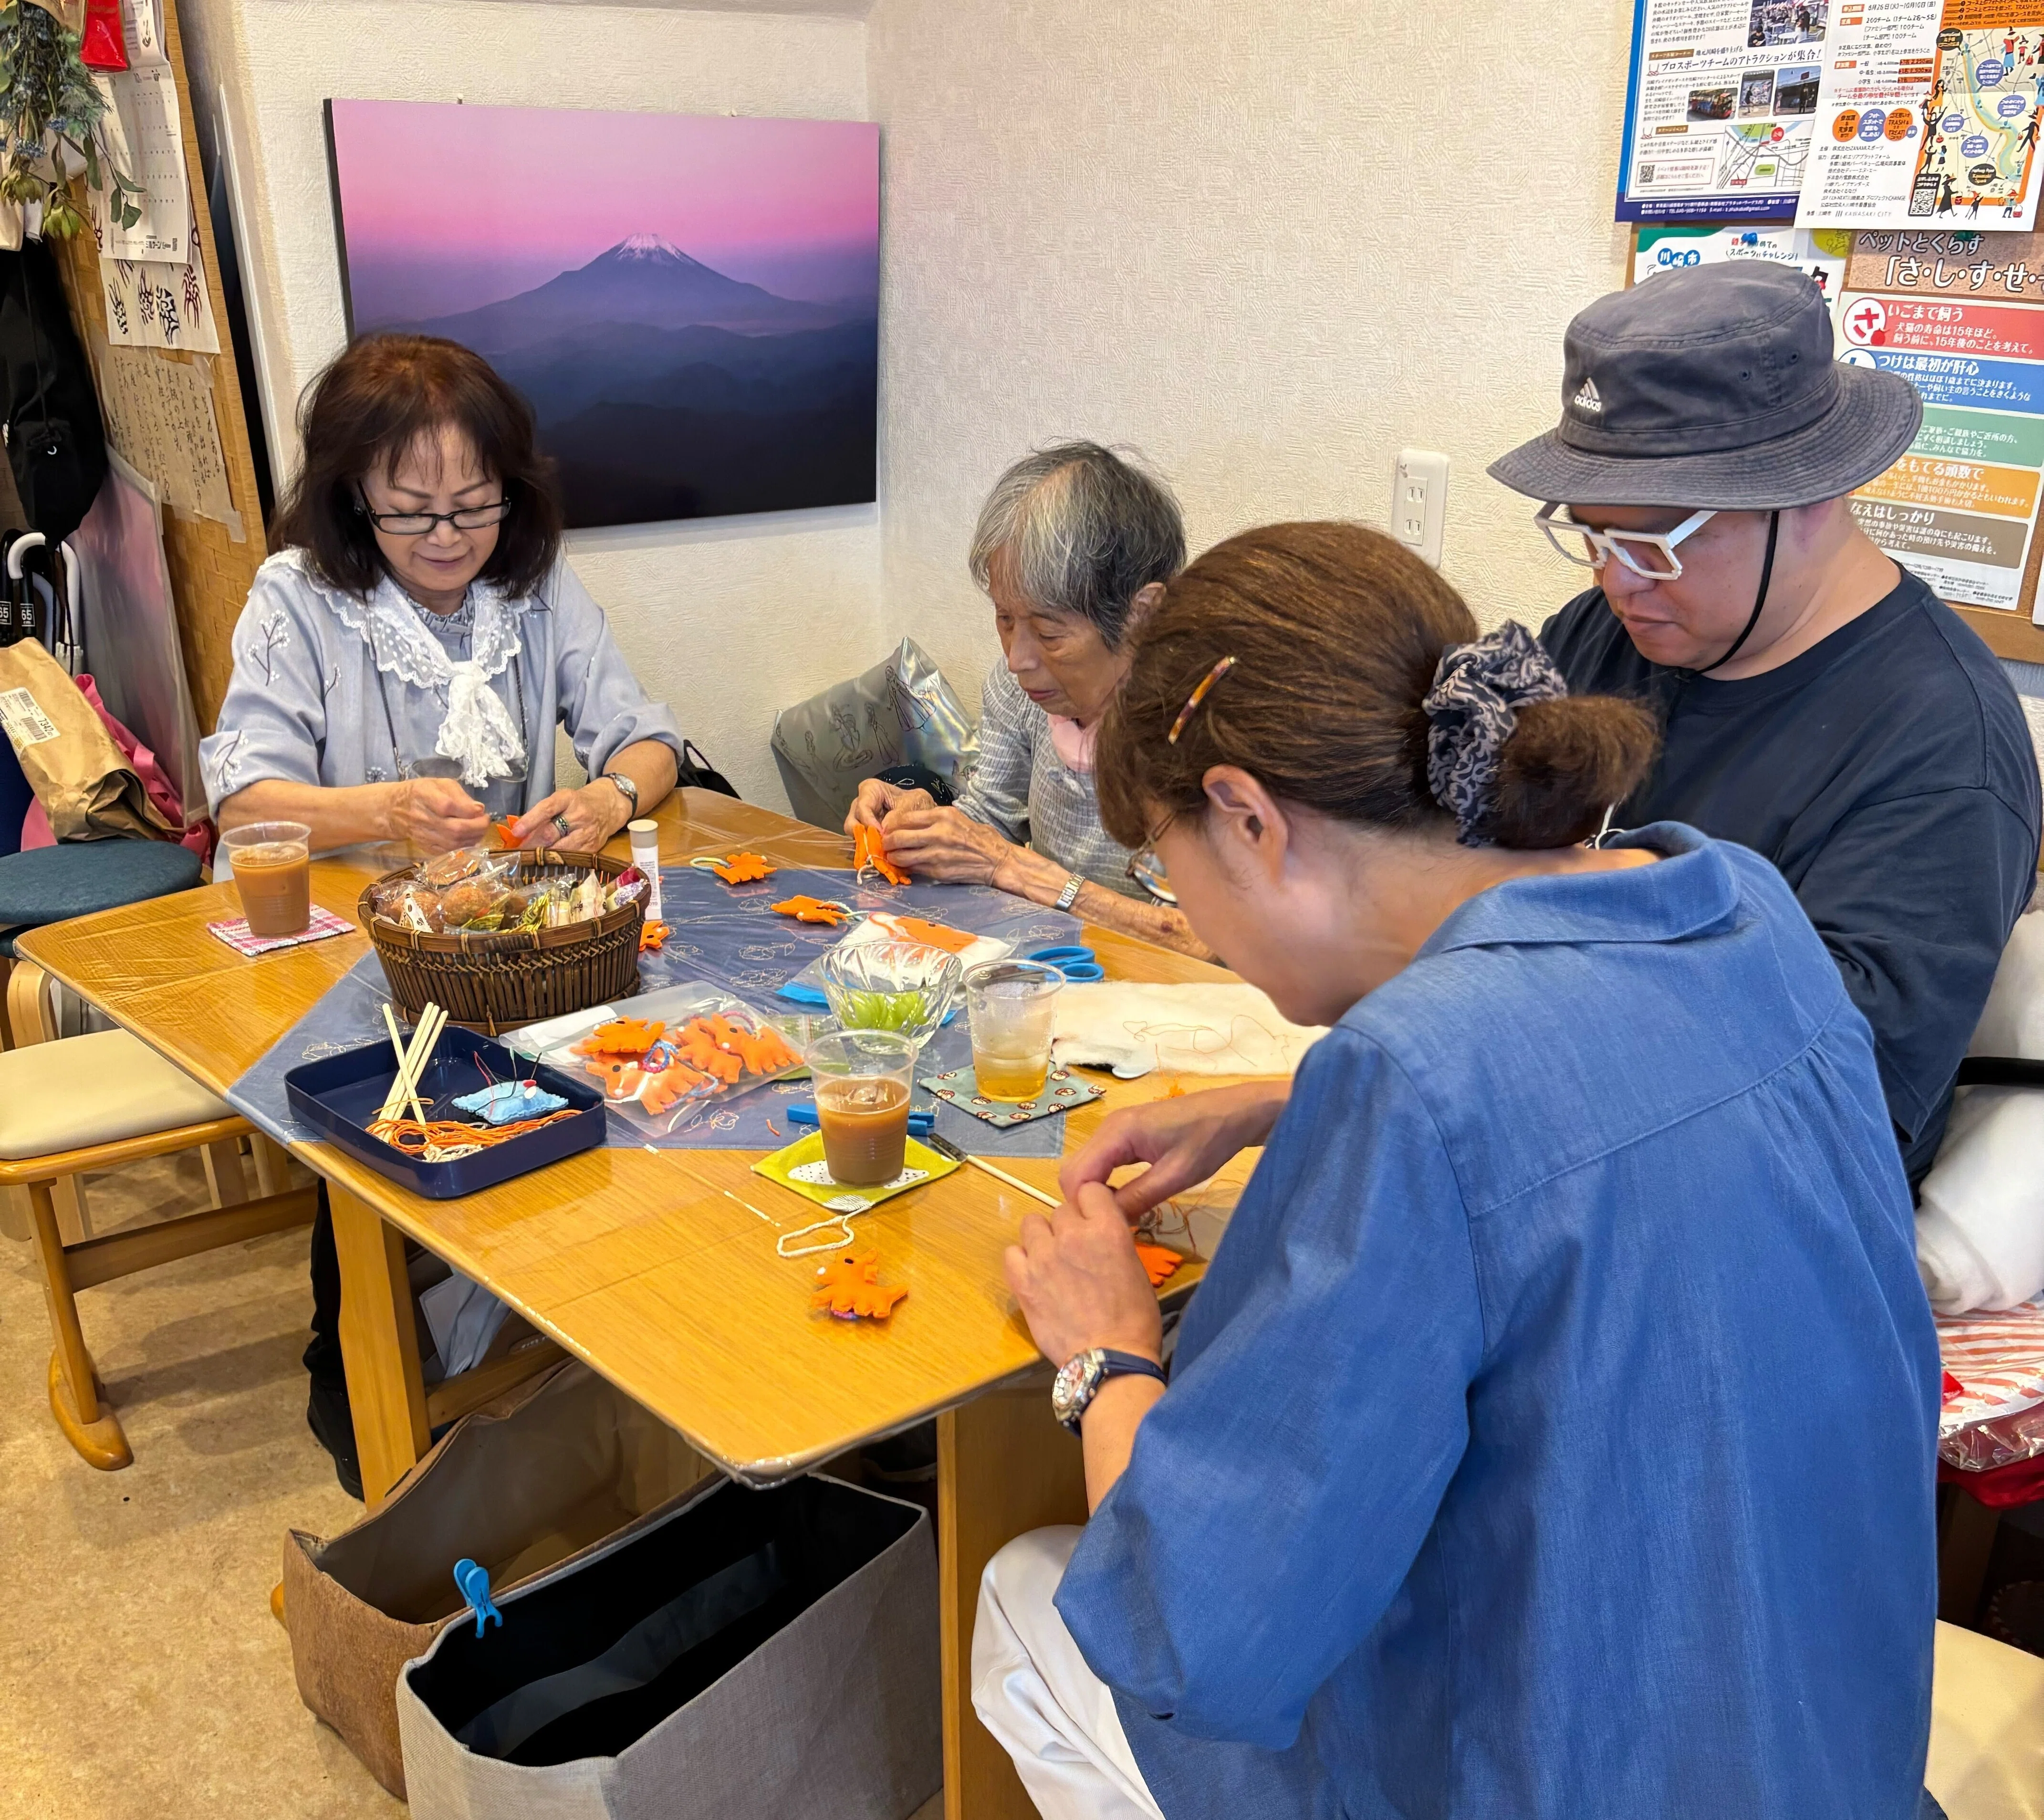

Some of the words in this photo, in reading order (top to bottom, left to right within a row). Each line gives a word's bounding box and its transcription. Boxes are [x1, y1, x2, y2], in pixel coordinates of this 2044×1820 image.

[1859, 230, 1984, 256] ペットとくらす
[1885, 255, 2044, 293] 「さ・し・す・せ・
[1854, 307, 1880, 339] さ
[1888, 304, 1964, 323] いごまで飼う
[1895, 323, 1998, 340] 犬猫の寿命は15年ほど。
[1893, 335, 2034, 355] 飼う前に、15年後のことを考えて。
[1878, 355, 1980, 376] つけは最初が肝心
[1890, 370, 2017, 391] の性格はほぼ1歳までに決まります。
[1910, 382, 2031, 401] ナーや飼い主の言うことをきくような
[1918, 391, 1953, 402] れまでに。
[1575, 395, 1602, 412] adidas
[1889, 458, 1984, 480] をもてる頭数で
[1850, 501, 1935, 526] なえはしっかり
[21, 609, 32, 620] 65
[38, 718, 54, 732] 7342
